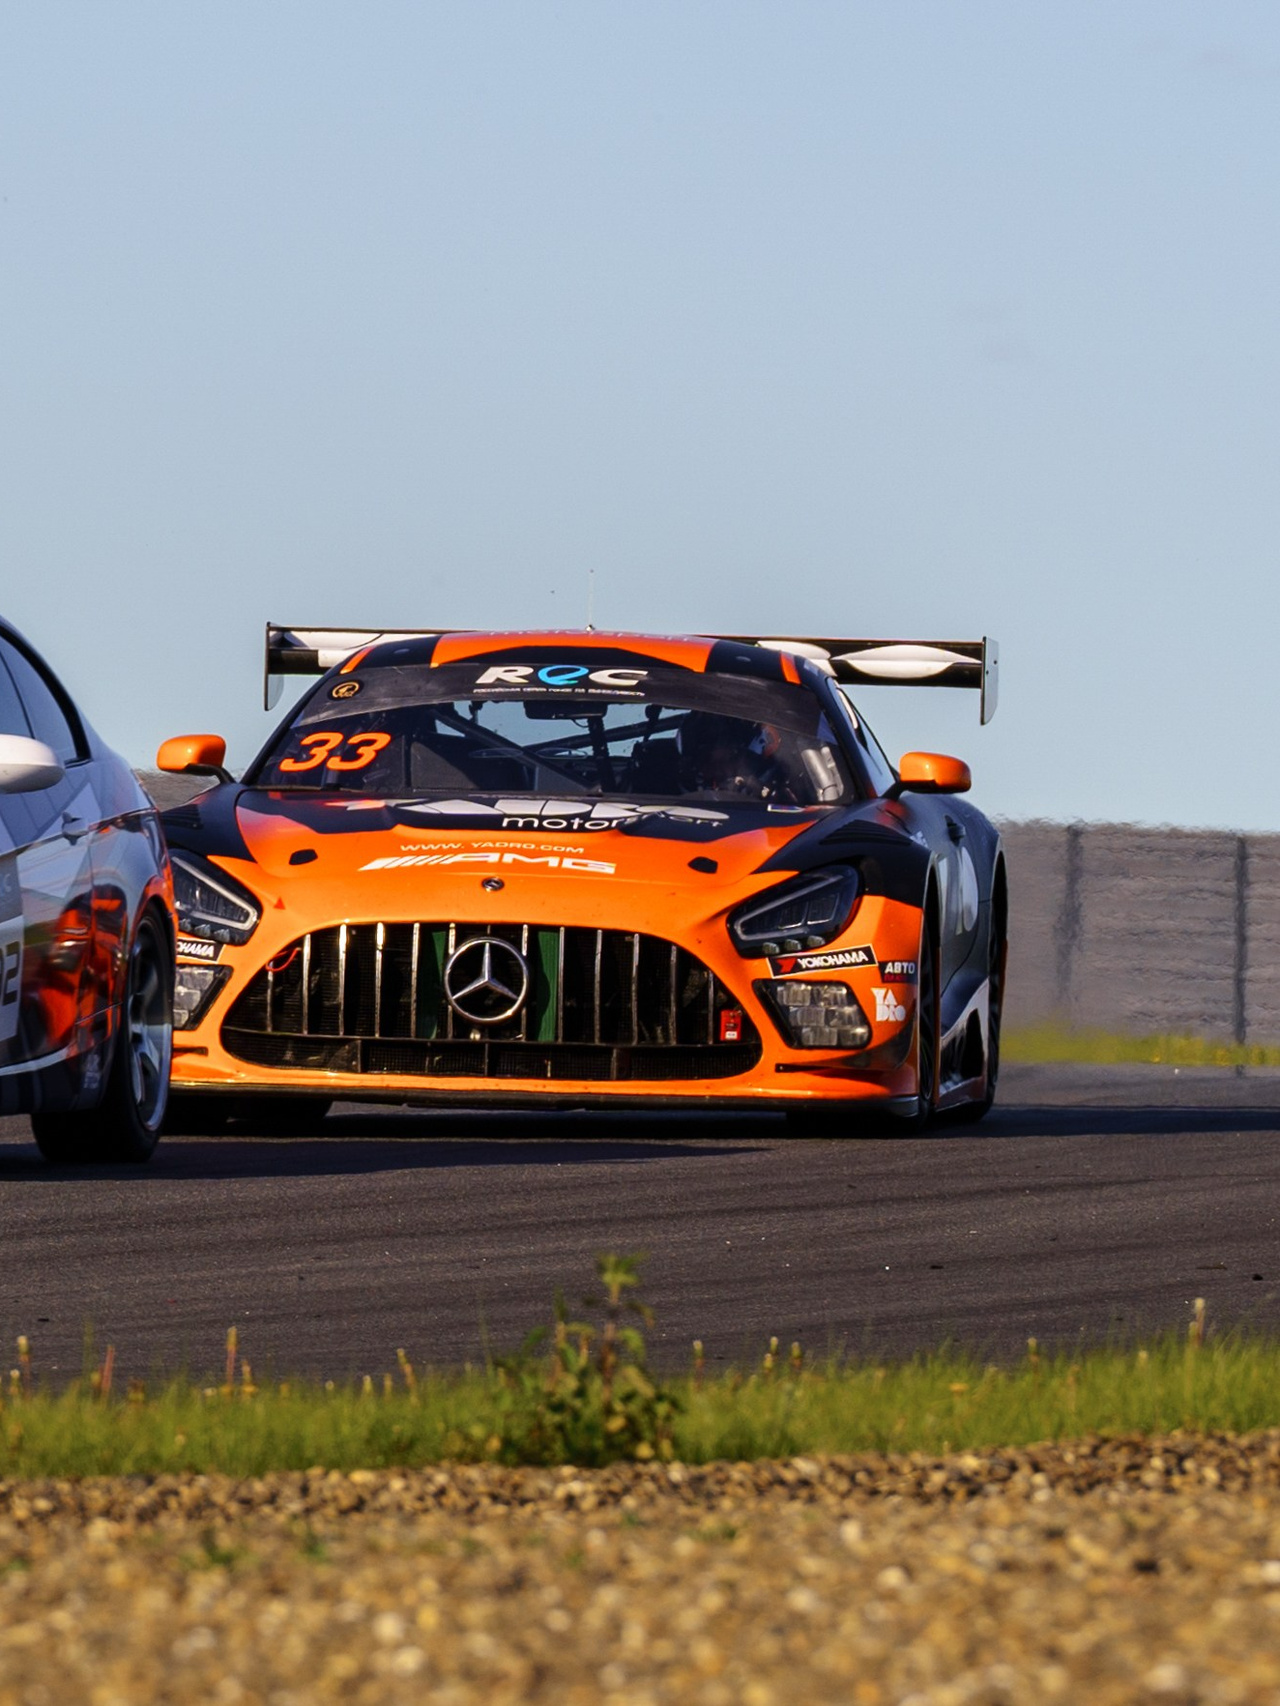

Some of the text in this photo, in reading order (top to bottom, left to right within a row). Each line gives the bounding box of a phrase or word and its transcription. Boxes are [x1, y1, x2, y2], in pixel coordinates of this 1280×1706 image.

[279, 732, 392, 772] 33
[400, 841, 585, 854] WWW. YADRO.COM
[438, 852, 617, 874] AMG
[175, 941, 215, 958] OHAMA
[797, 950, 869, 969] YOKOHAMA
